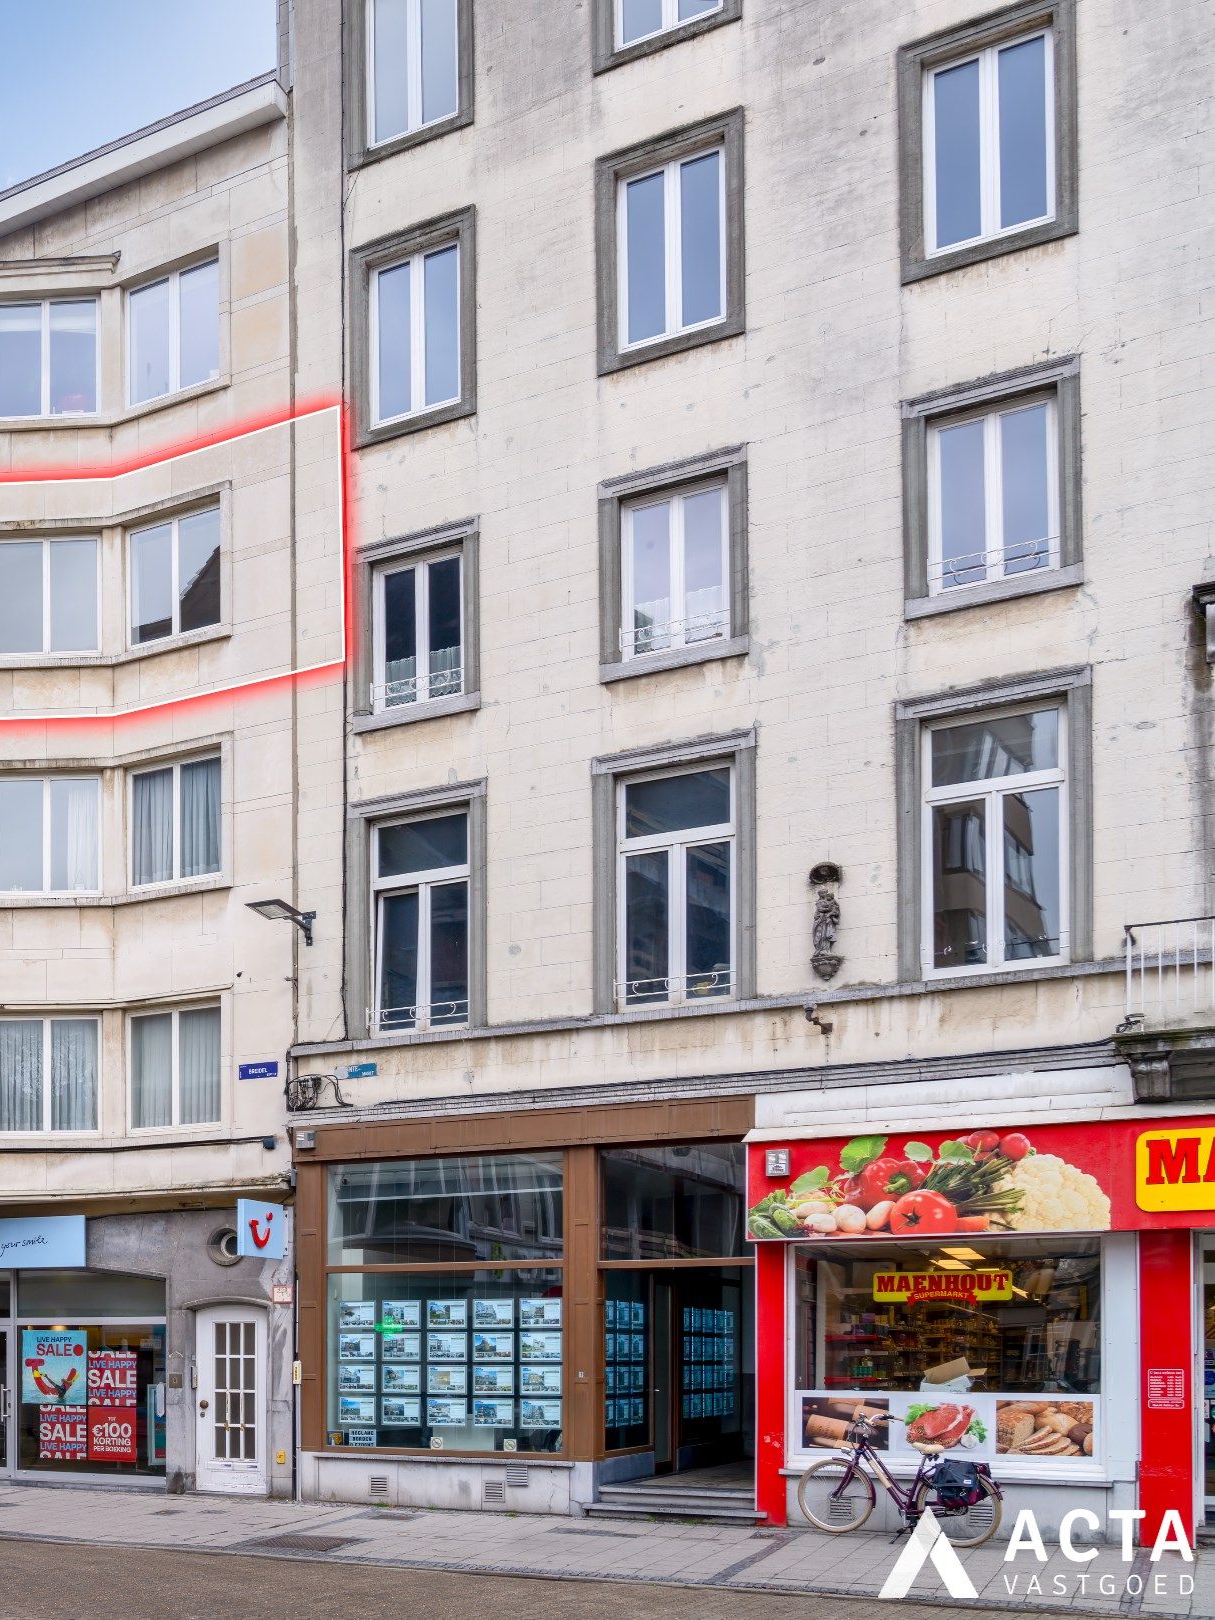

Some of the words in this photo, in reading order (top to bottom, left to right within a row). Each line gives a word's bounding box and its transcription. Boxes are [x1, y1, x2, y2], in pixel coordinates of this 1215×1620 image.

[1146, 1137, 1215, 1185] M
[0, 1241, 21, 1257] your
[21, 1235, 48, 1247] smile
[877, 1274, 1009, 1292] MAENHOUT
[914, 1290, 969, 1299] SUPERMARKT
[36, 1344, 72, 1356] SALE
[108, 1361, 136, 1369] HAPPY
[88, 1369, 137, 1388] SALE
[108, 1390, 136, 1398] HAPPY
[40, 1414, 57, 1422] LIVE
[59, 1415, 86, 1423] HAPPY
[40, 1423, 86, 1441] SALE
[92, 1423, 132, 1438] €100
[40, 1442, 57, 1450] LIVE
[59, 1443, 86, 1451] HAPPY
[93, 1437, 131, 1446] KORTING
